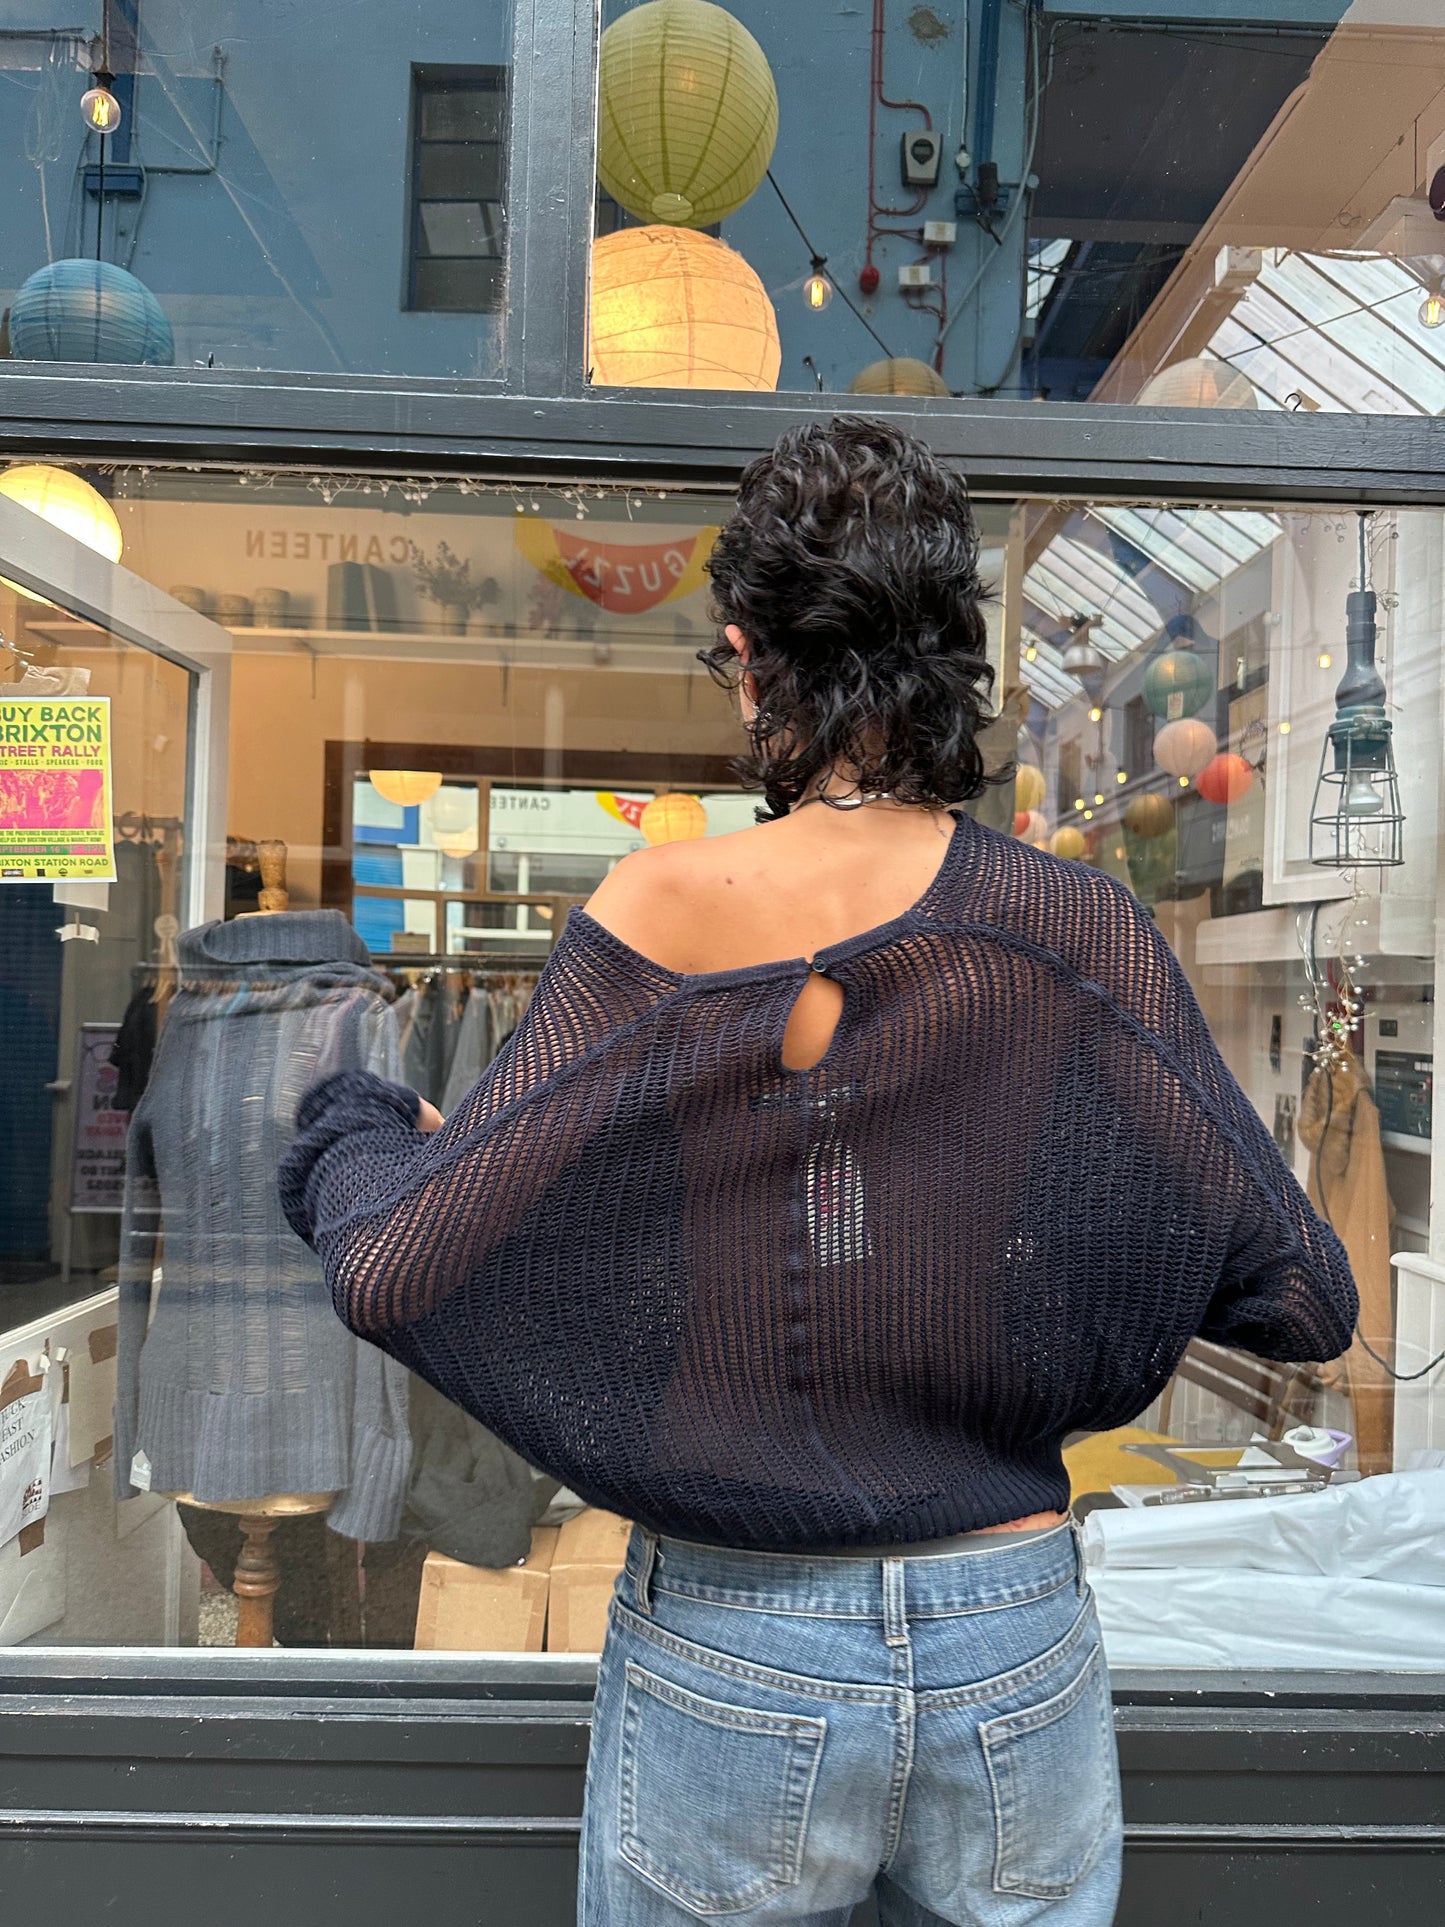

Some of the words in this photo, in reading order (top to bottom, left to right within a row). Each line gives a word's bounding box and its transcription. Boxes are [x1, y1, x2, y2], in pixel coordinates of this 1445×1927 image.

[0, 707, 33, 722] UY
[40, 706, 101, 722] BACK
[51, 745, 101, 757] RALLY
[34, 858, 77, 866] STATION
[80, 858, 109, 866] ROAD
[2, 1416, 23, 1442] FAST
